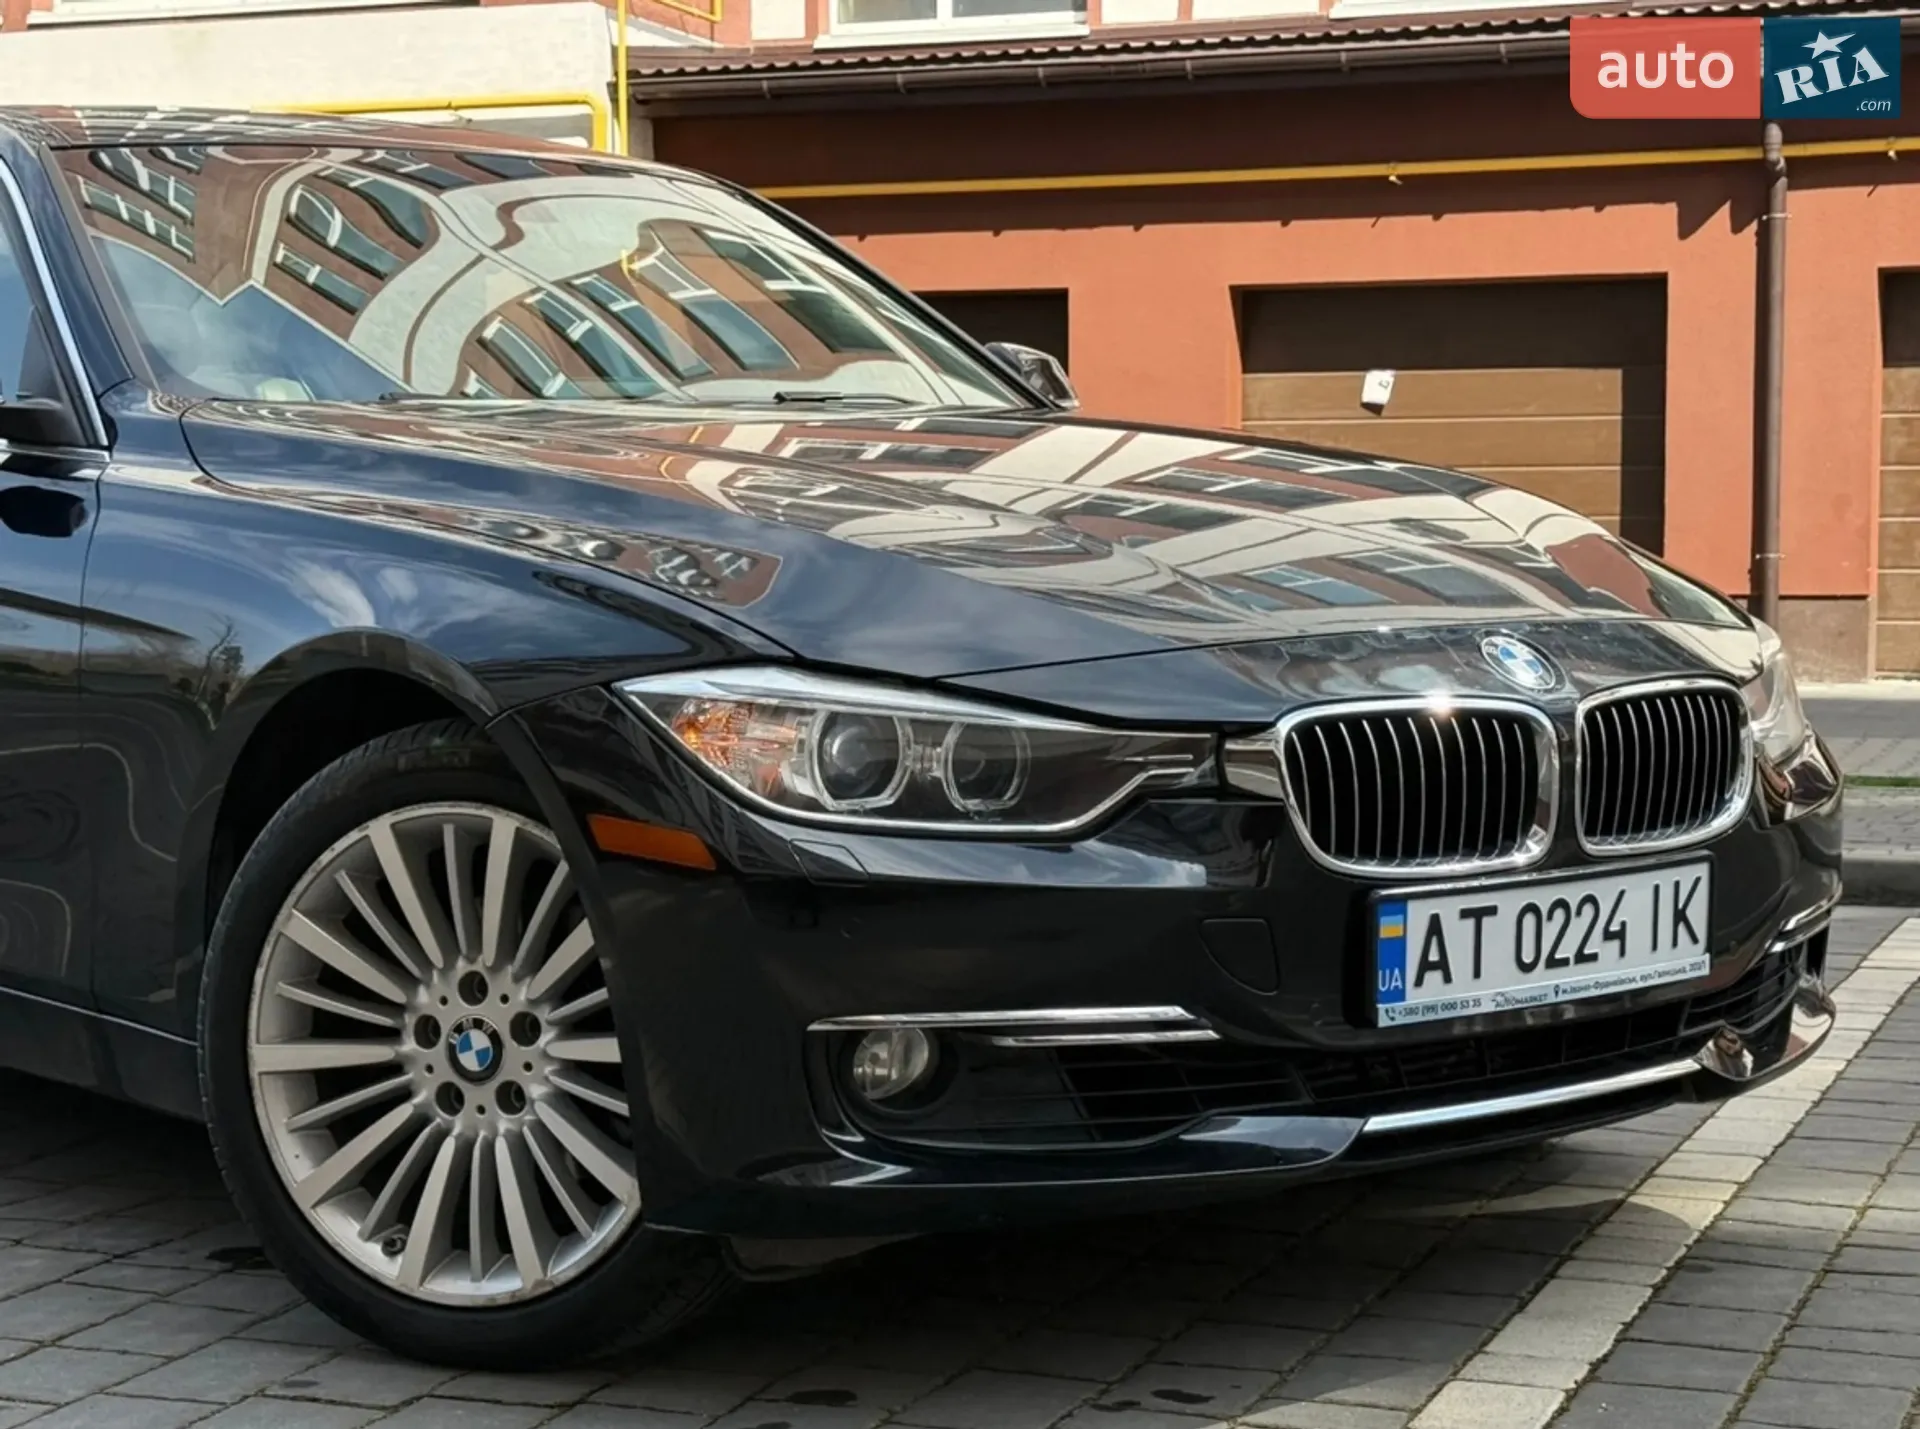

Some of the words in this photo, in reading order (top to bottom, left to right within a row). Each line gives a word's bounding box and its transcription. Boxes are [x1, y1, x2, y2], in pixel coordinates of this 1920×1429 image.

[1413, 904, 1499, 988] AT
[1514, 888, 1627, 974] 0224
[1651, 875, 1703, 953] IK
[1379, 968, 1403, 993] UA
[1440, 1002, 1458, 1012] 000
[448, 1018, 495, 1045] BMW
